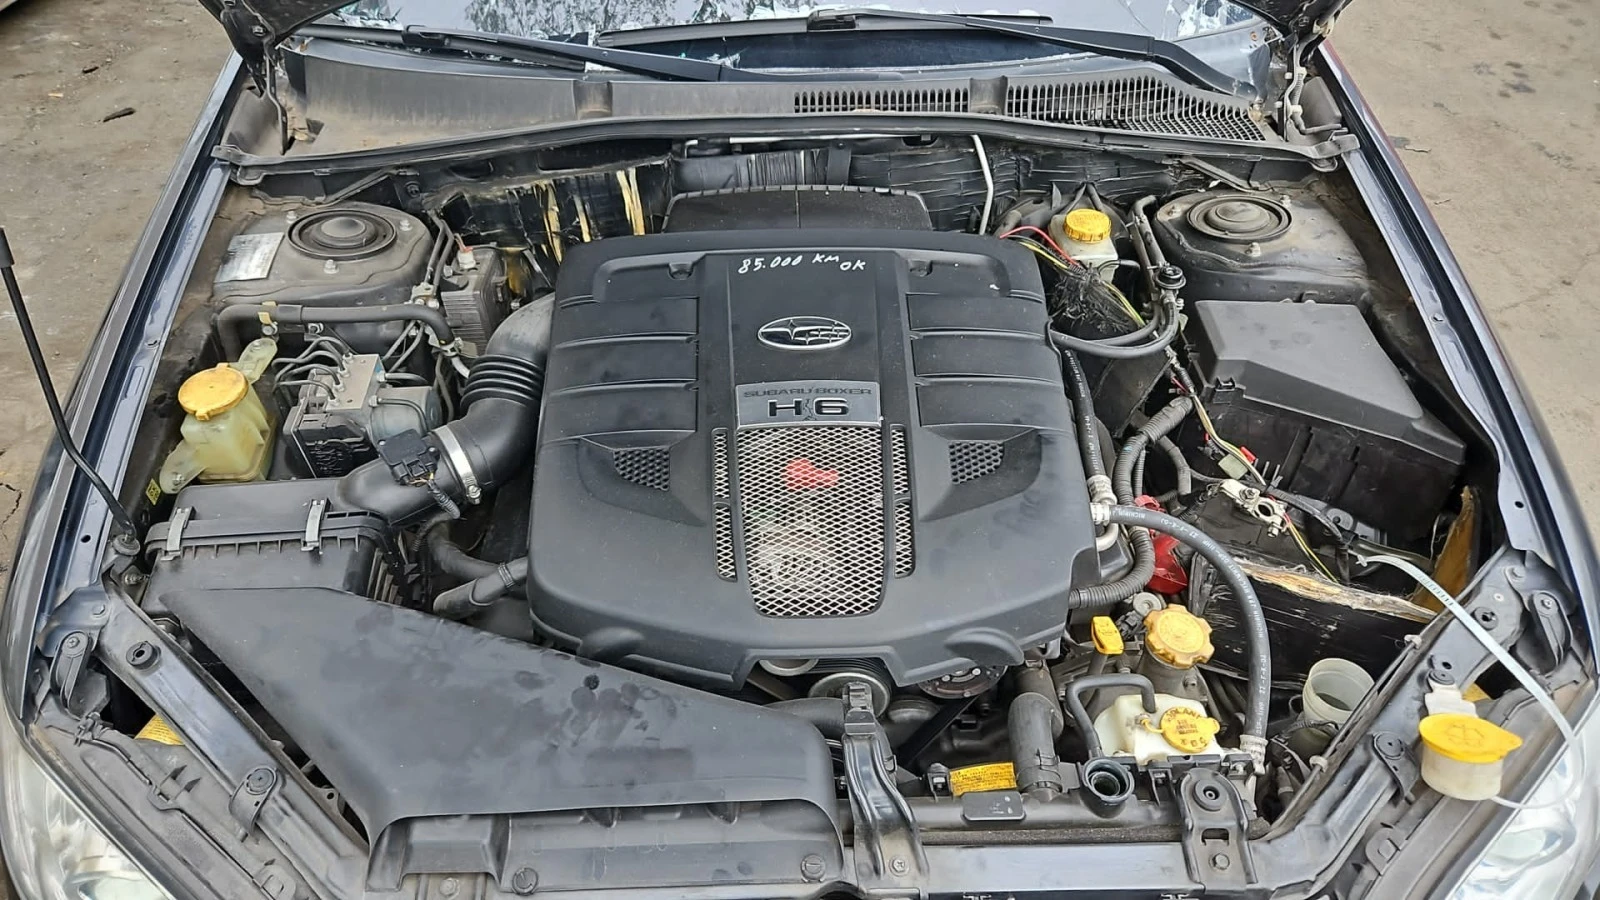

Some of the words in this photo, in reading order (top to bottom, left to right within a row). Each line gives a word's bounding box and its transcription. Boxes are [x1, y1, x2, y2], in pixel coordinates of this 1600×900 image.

[738, 255, 803, 274] 85.000
[839, 259, 866, 271] OK
[744, 387, 810, 397] SUBARU
[811, 387, 872, 395] BOXER
